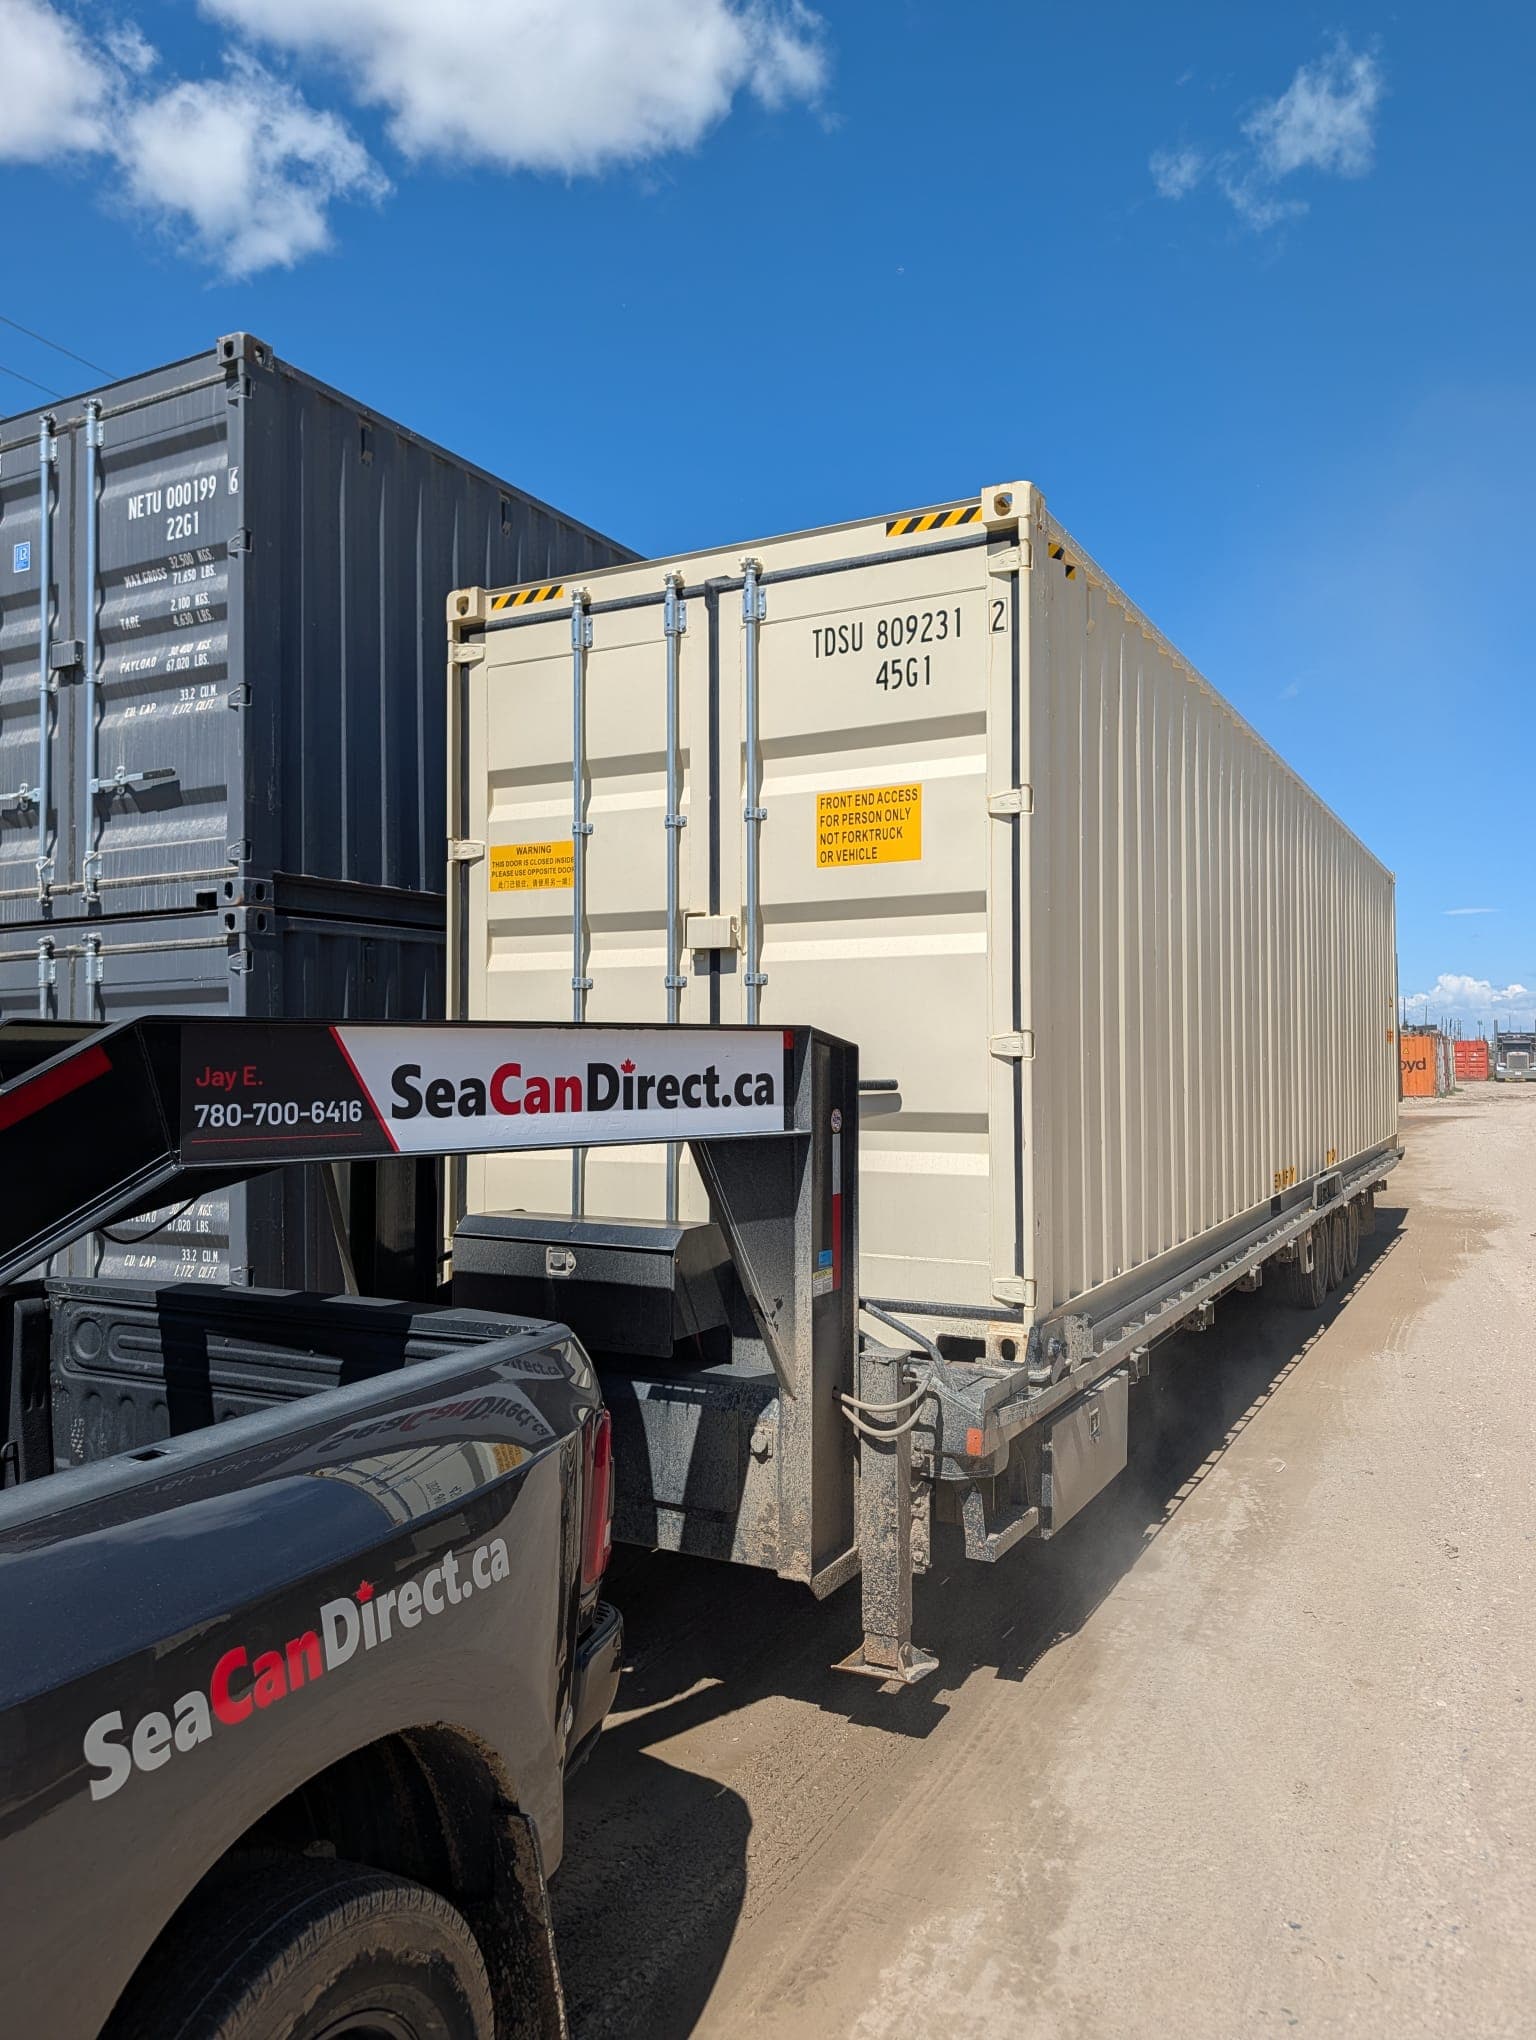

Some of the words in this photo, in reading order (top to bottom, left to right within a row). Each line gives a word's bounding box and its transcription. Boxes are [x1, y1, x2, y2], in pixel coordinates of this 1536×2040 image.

[128, 489, 162, 520] NETU
[166, 475, 217, 510] 000199
[230, 469, 239, 492] 6
[167, 511, 199, 541] 22G1
[201, 564, 217, 579] LBS.
[120, 615, 142, 631] TARE
[813, 622, 863, 659] TDSU
[876, 606, 961, 650] 809231
[991, 600, 1005, 632] 2
[120, 656, 158, 674] PAYLOAD
[194, 653, 210, 667] LBS.
[876, 655, 931, 691] 45G1
[180, 687, 196, 702] 33.2
[820, 795, 853, 810] FRONT
[855, 793, 875, 807] END
[876, 788, 918, 805] ACCESS
[820, 815, 840, 828] FOR
[842, 811, 882, 826] PERSON
[884, 808, 912, 821] ONLY
[820, 832, 840, 846] NOT
[842, 826, 903, 844] FORKTRUCK
[516, 845, 552, 855] WARNING
[820, 850, 834, 863] OR
[836, 847, 878, 862] VEHICLE
[506, 860, 523, 868] DOOR
[530, 858, 553, 866] CLOSED
[491, 870, 514, 878] PLEASE
[515, 869, 527, 877] USE
[528, 868, 557, 876] OPPOSITE
[195, 1066, 237, 1092] Jay
[243, 1066, 264, 1086] E.
[391, 1058, 775, 1120] SeaCanDirect.ca
[194, 1100, 363, 1129] 780-700-6416
[196, 1220, 212, 1233] LBS.
[181, 1248, 197, 1262] 33.2
[83, 1537, 511, 1802] SeaCanDirect.ca
